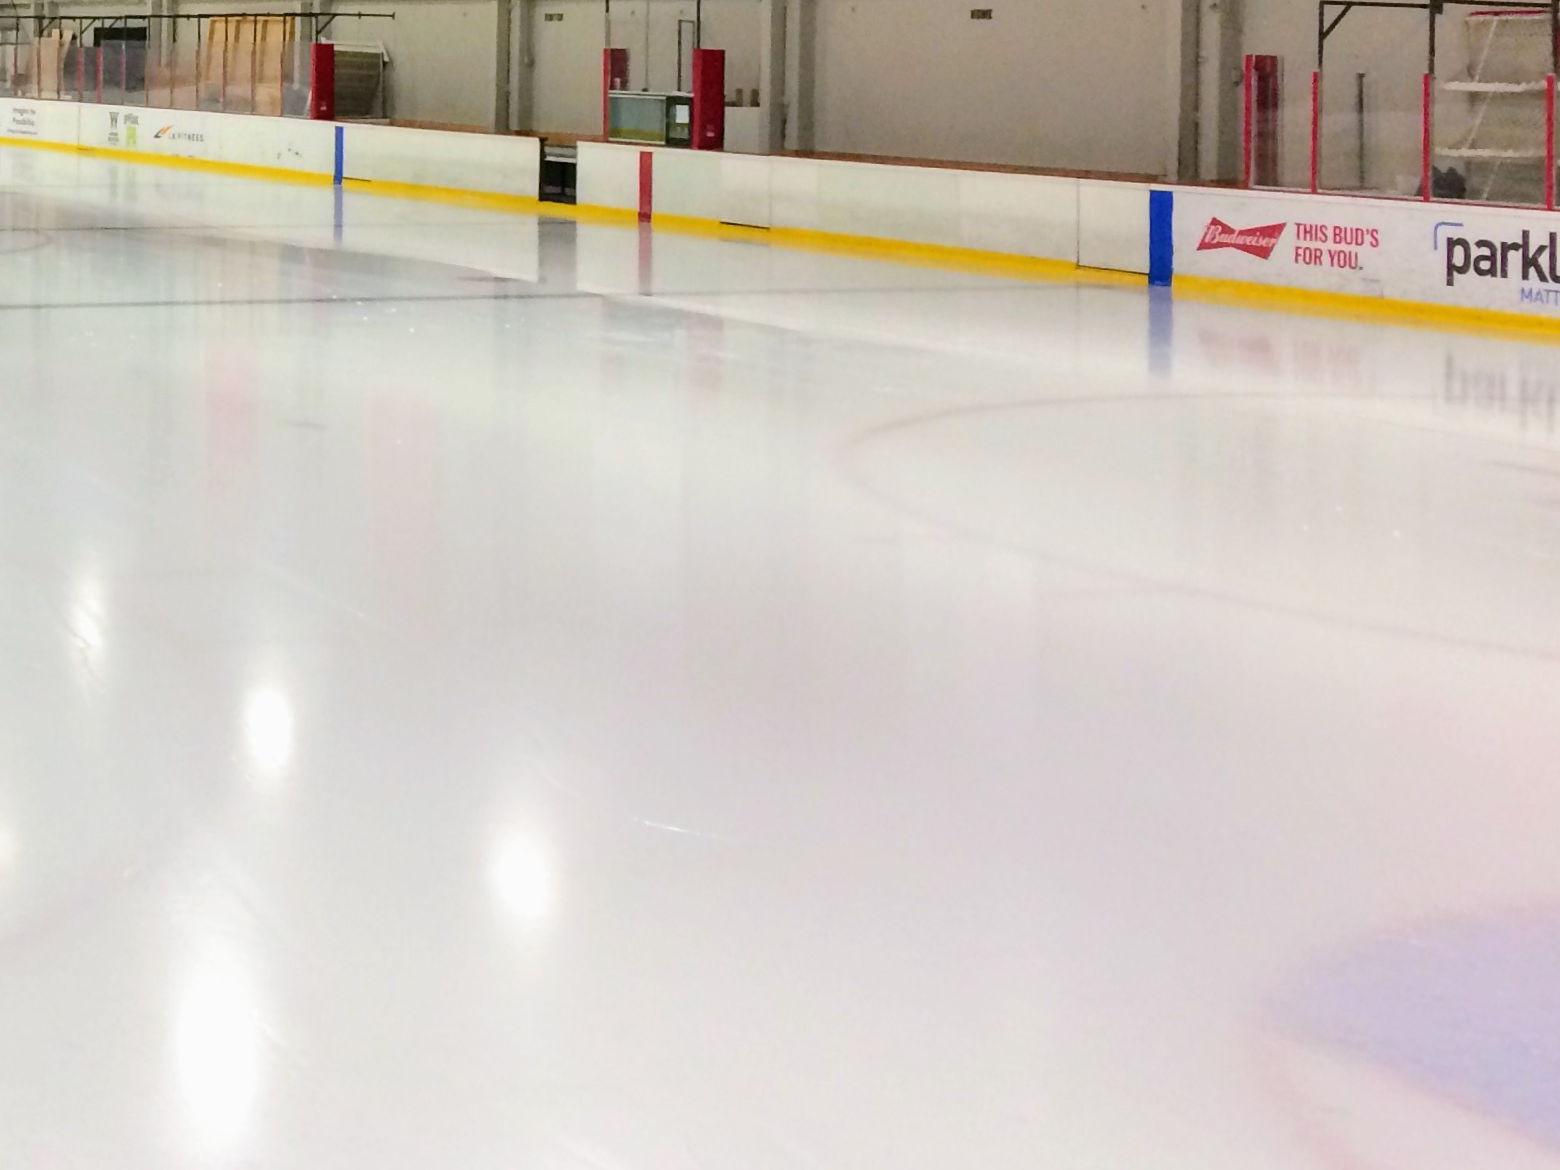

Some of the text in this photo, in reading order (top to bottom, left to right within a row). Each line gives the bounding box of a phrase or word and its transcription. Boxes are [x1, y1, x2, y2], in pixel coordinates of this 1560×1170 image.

[1206, 224, 1277, 248] Budweiser
[1295, 222, 1380, 248] THIS BUD'S
[1294, 246, 1364, 271] FOR YOU.
